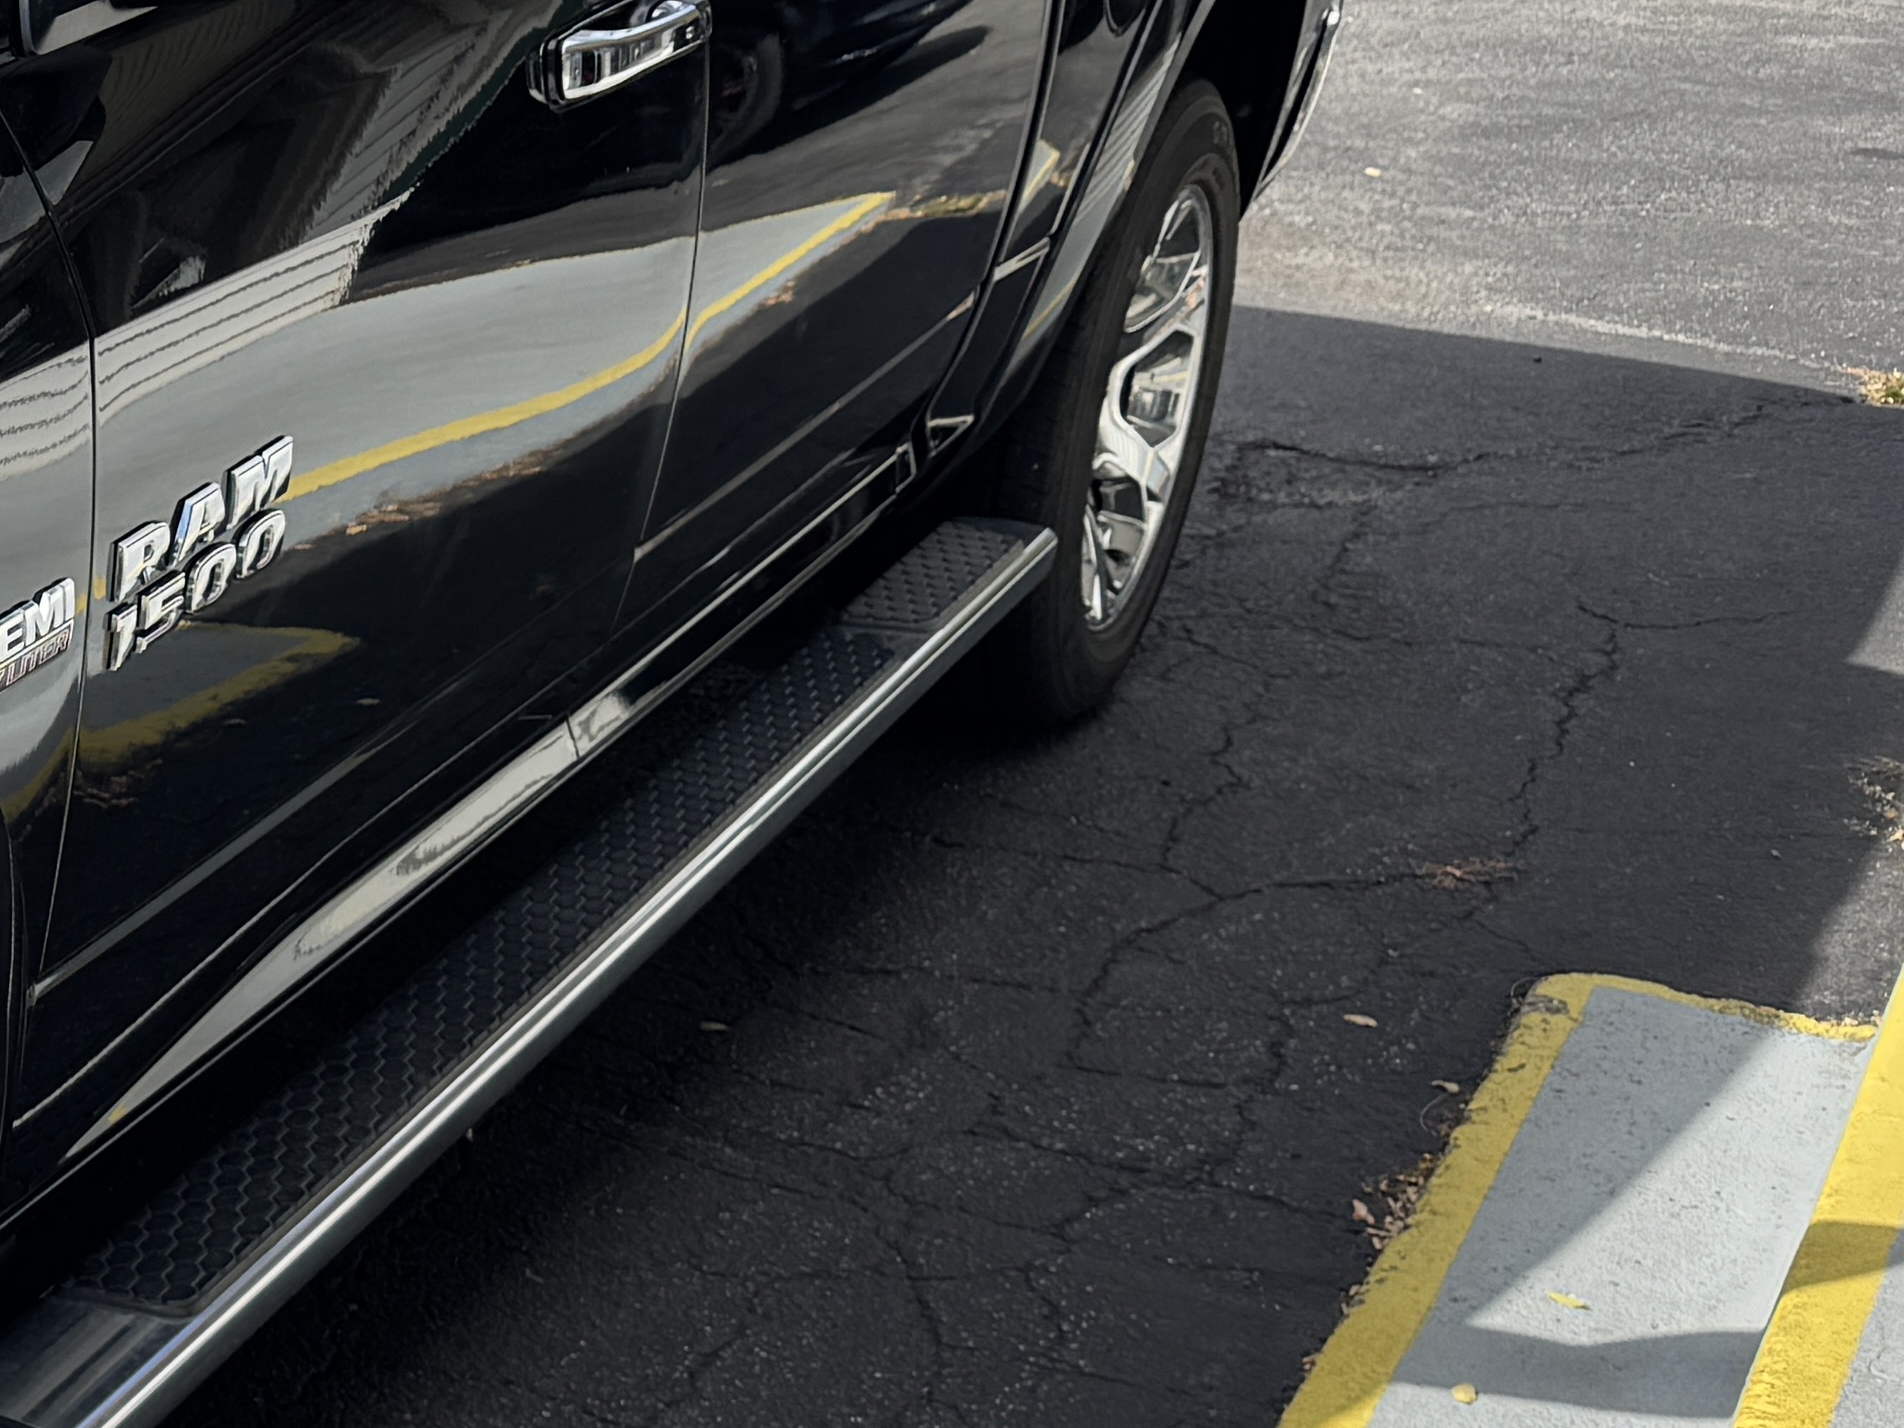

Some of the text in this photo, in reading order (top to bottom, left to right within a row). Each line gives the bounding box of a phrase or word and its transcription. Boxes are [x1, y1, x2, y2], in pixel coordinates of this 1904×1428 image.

[103, 508, 286, 671] 1500
[107, 434, 293, 603] RAM
[6, 627, 70, 686] LITER
